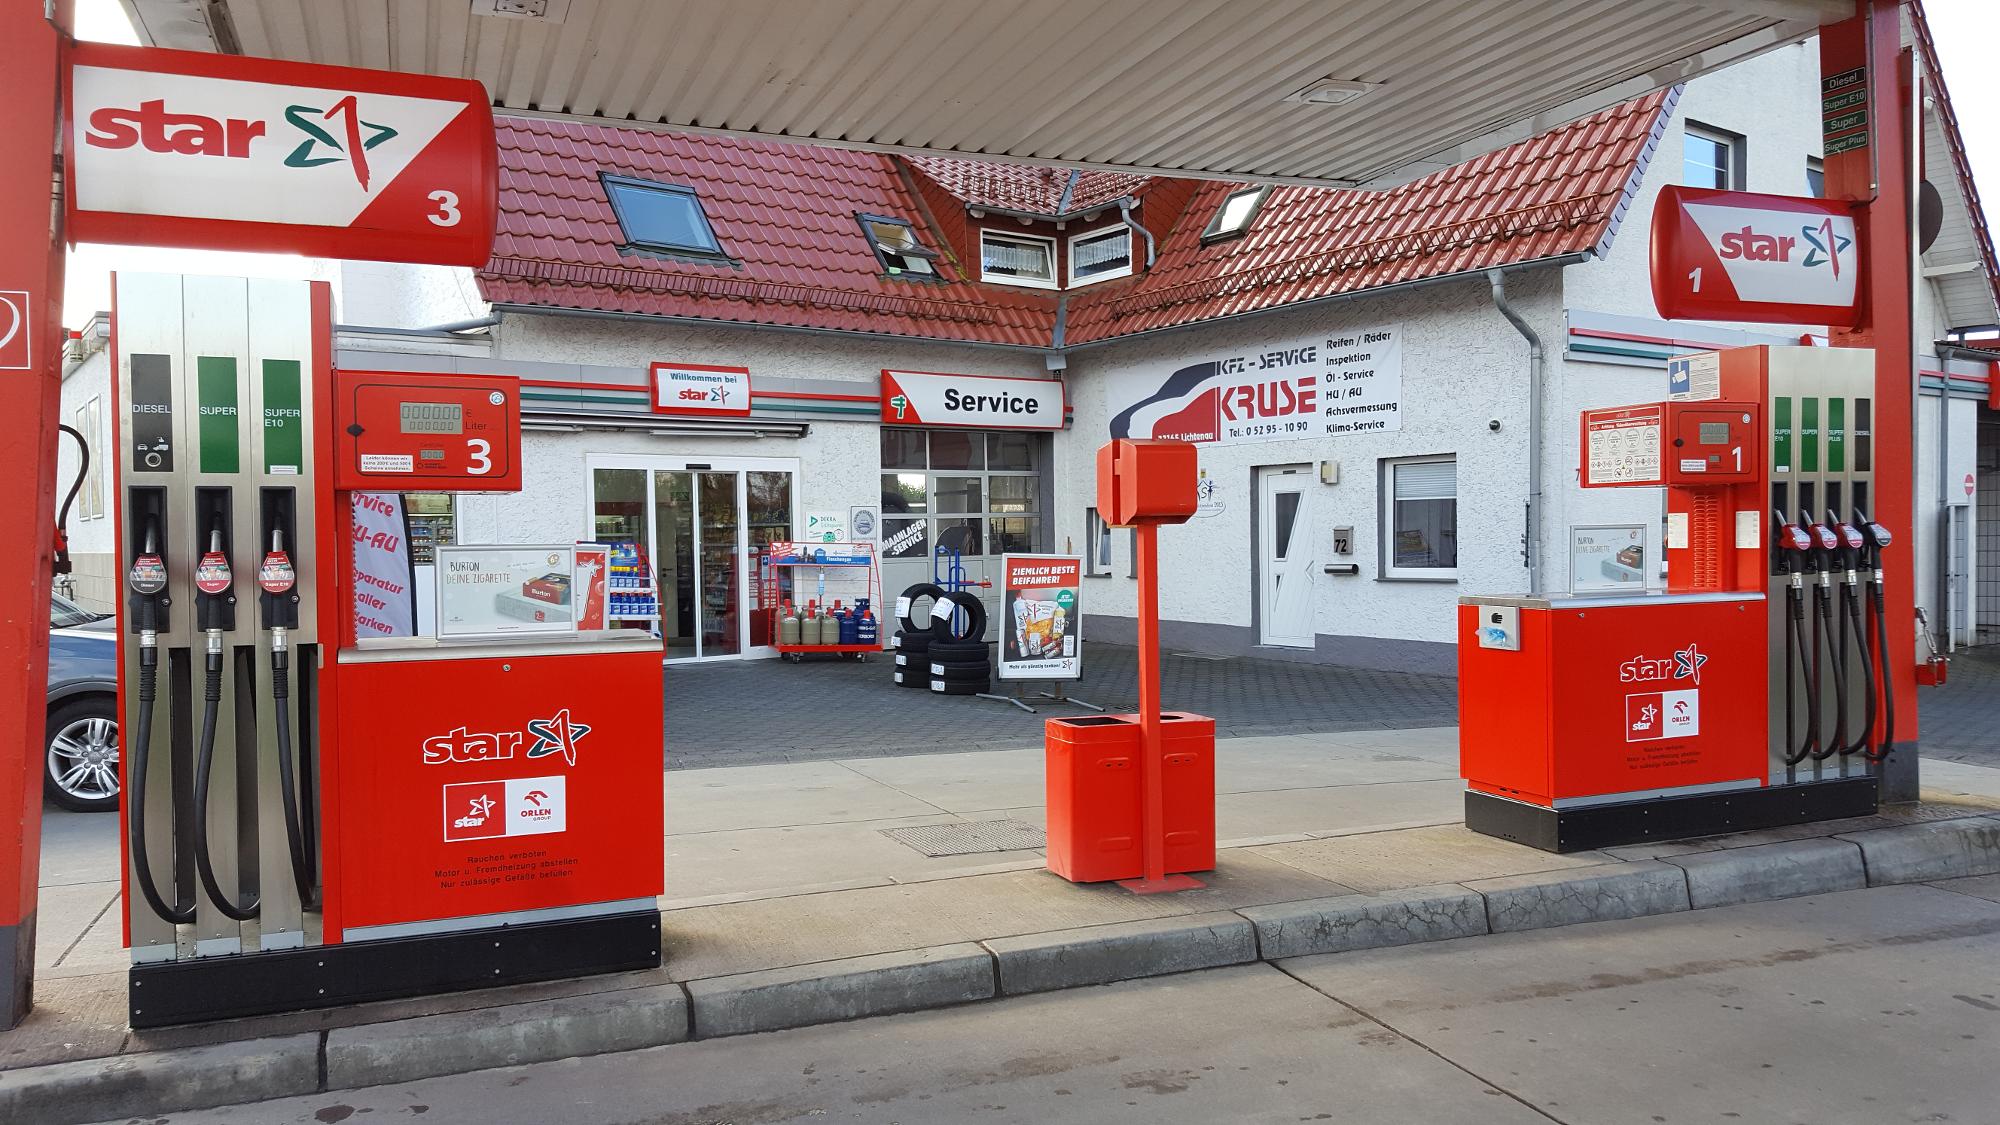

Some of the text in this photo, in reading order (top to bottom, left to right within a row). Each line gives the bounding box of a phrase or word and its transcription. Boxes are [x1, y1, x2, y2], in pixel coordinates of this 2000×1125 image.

[1829, 72, 1857, 88] Diesel
[1824, 91, 1864, 110] Super E10
[85, 99, 265, 158] star
[1830, 116, 1858, 130] Super
[1825, 135, 1865, 152] Super Plus
[427, 190, 461, 226] 3
[1719, 225, 1795, 263] star
[1688, 267, 1702, 293] 1
[1327, 338, 1354, 349] Reifen
[1364, 332, 1391, 344] Räder
[1217, 357, 1245, 375] KFZ
[1326, 353, 1371, 366] Inspektion
[670, 372, 722, 382] Willkommen
[1344, 369, 1374, 380] Service
[678, 388, 708, 400] star
[1217, 376, 1316, 421] KRUSE
[1326, 390, 1339, 400] HU
[1349, 387, 1362, 398] AU
[945, 388, 1038, 414] Service
[133, 404, 171, 414] DIESEL
[200, 406, 236, 415] SUPER
[265, 409, 300, 417] SUPER
[1326, 402, 1397, 417] Achsvermessung
[265, 419, 283, 427] E10
[465, 421, 487, 430] Liter
[1229, 428, 1244, 437] Tel.:
[1246, 427, 1251, 436] 0
[1254, 426, 1263, 435] 52
[1267, 425, 1276, 433] 95
[1285, 423, 1294, 432] 10
[1297, 421, 1307, 431] 90
[1326, 420, 1385, 433] Klima-Service
[467, 438, 492, 474] 3
[1731, 446, 1741, 471] 1
[353, 493, 394, 517] rvice
[1335, 539, 1346, 552] 72
[450, 562, 480, 571] BURTON
[1012, 566, 1075, 576] ZIEMLICH BESTE
[446, 573, 511, 584] DEINE ZIGARETTE
[1012, 576, 1060, 585] BEIFAHRER!
[357, 592, 386, 610] aller
[355, 612, 393, 635] arken
[1620, 655, 1671, 682] star
[1672, 715, 1690, 723] ORLEN
[1632, 721, 1651, 731] star
[422, 727, 522, 765] star
[520, 809, 551, 817] ORLEN
[454, 816, 485, 828] star
[467, 850, 546, 863] Rauchen verboten
[435, 870, 460, 878] Motor
[476, 862, 536, 873] Fremdheizung
[541, 858, 578, 868] abstellen
[460, 877, 501, 887] zulässige
